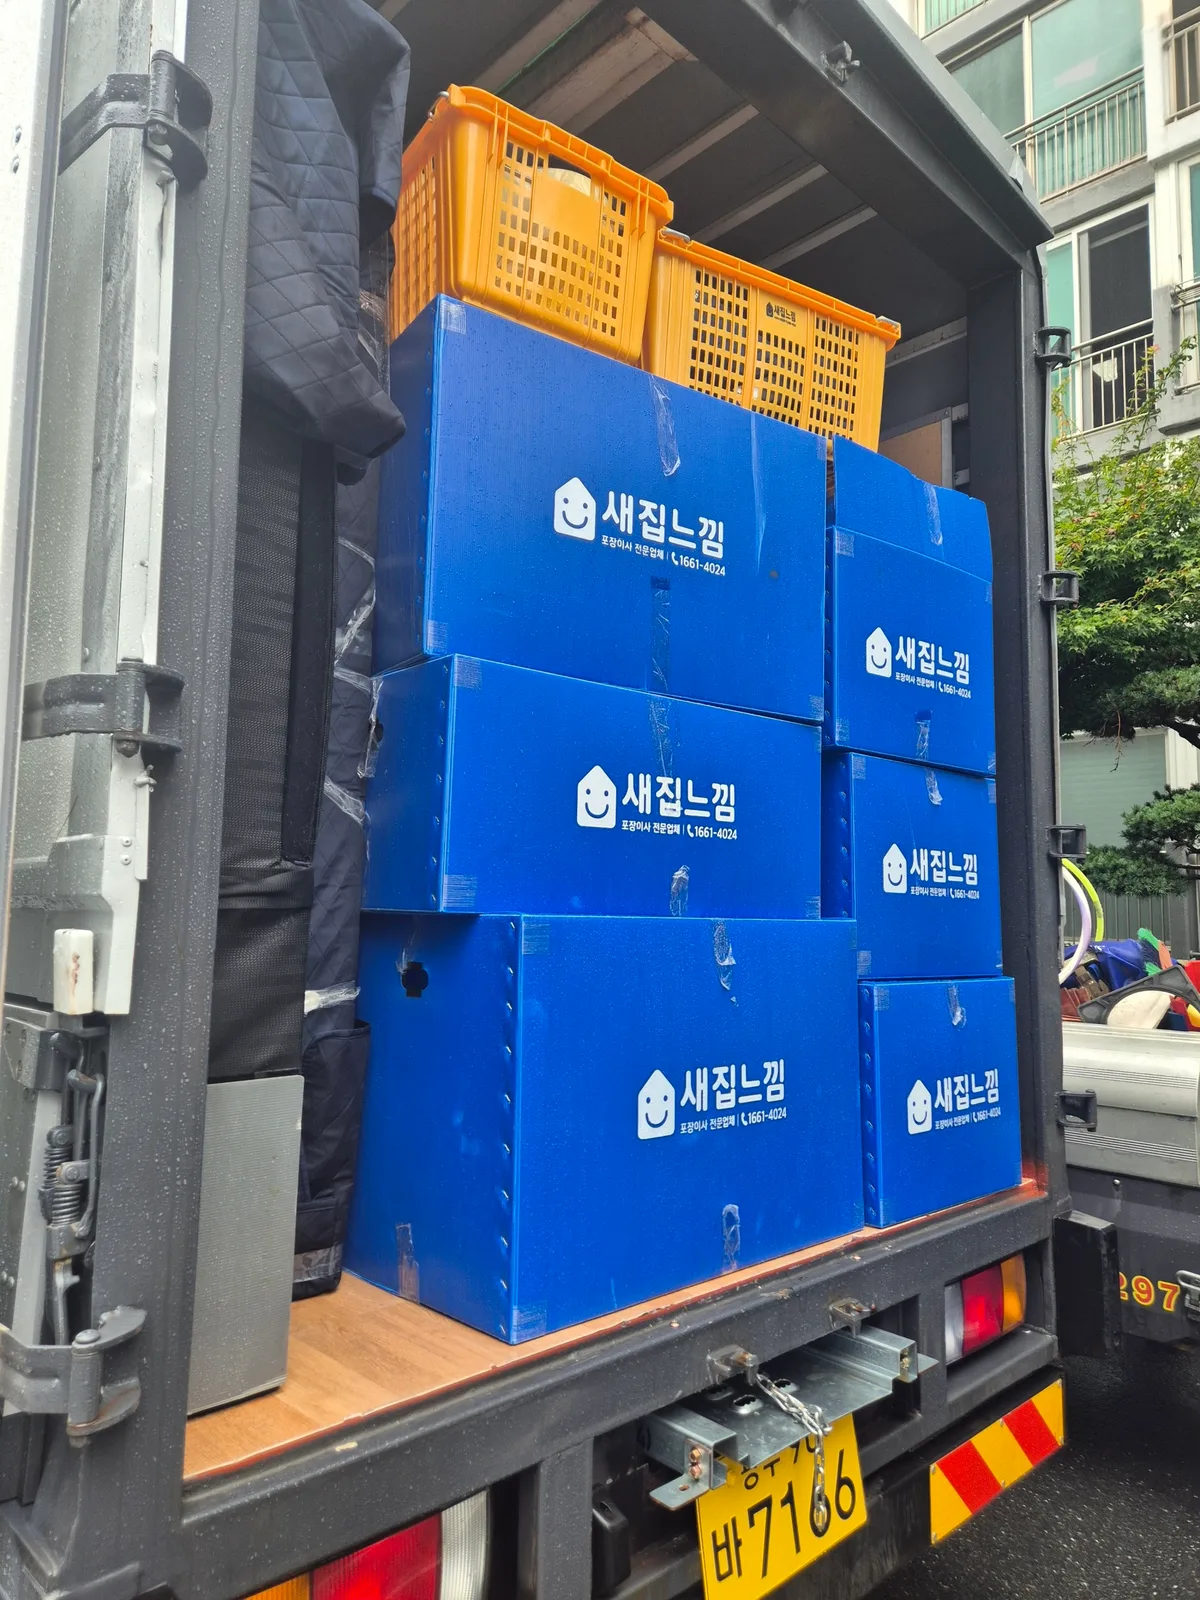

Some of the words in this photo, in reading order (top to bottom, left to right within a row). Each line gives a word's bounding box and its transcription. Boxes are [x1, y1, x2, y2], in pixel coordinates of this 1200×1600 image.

[601, 490, 724, 559] 새집느낌
[601, 534, 632, 552] 포장이사
[634, 543, 664, 560] 전문업체
[679, 554, 726, 576] 1661-4024
[895, 635, 970, 685] 새집느낌
[943, 683, 972, 699] 1661-4024
[621, 772, 736, 823] 새집느낌
[621, 819, 651, 833] 포장이사
[652, 822, 681, 835] 전문업체
[694, 825, 738, 840] 1661-4024
[909, 847, 978, 886] 새집느낌
[679, 1058, 785, 1113] 새집느낌
[933, 1068, 1000, 1113] 새집느낌
[679, 1118, 708, 1134] 포장이사
[709, 1114, 736, 1130] 전문업체
[747, 1106, 787, 1125] 1661-4024
